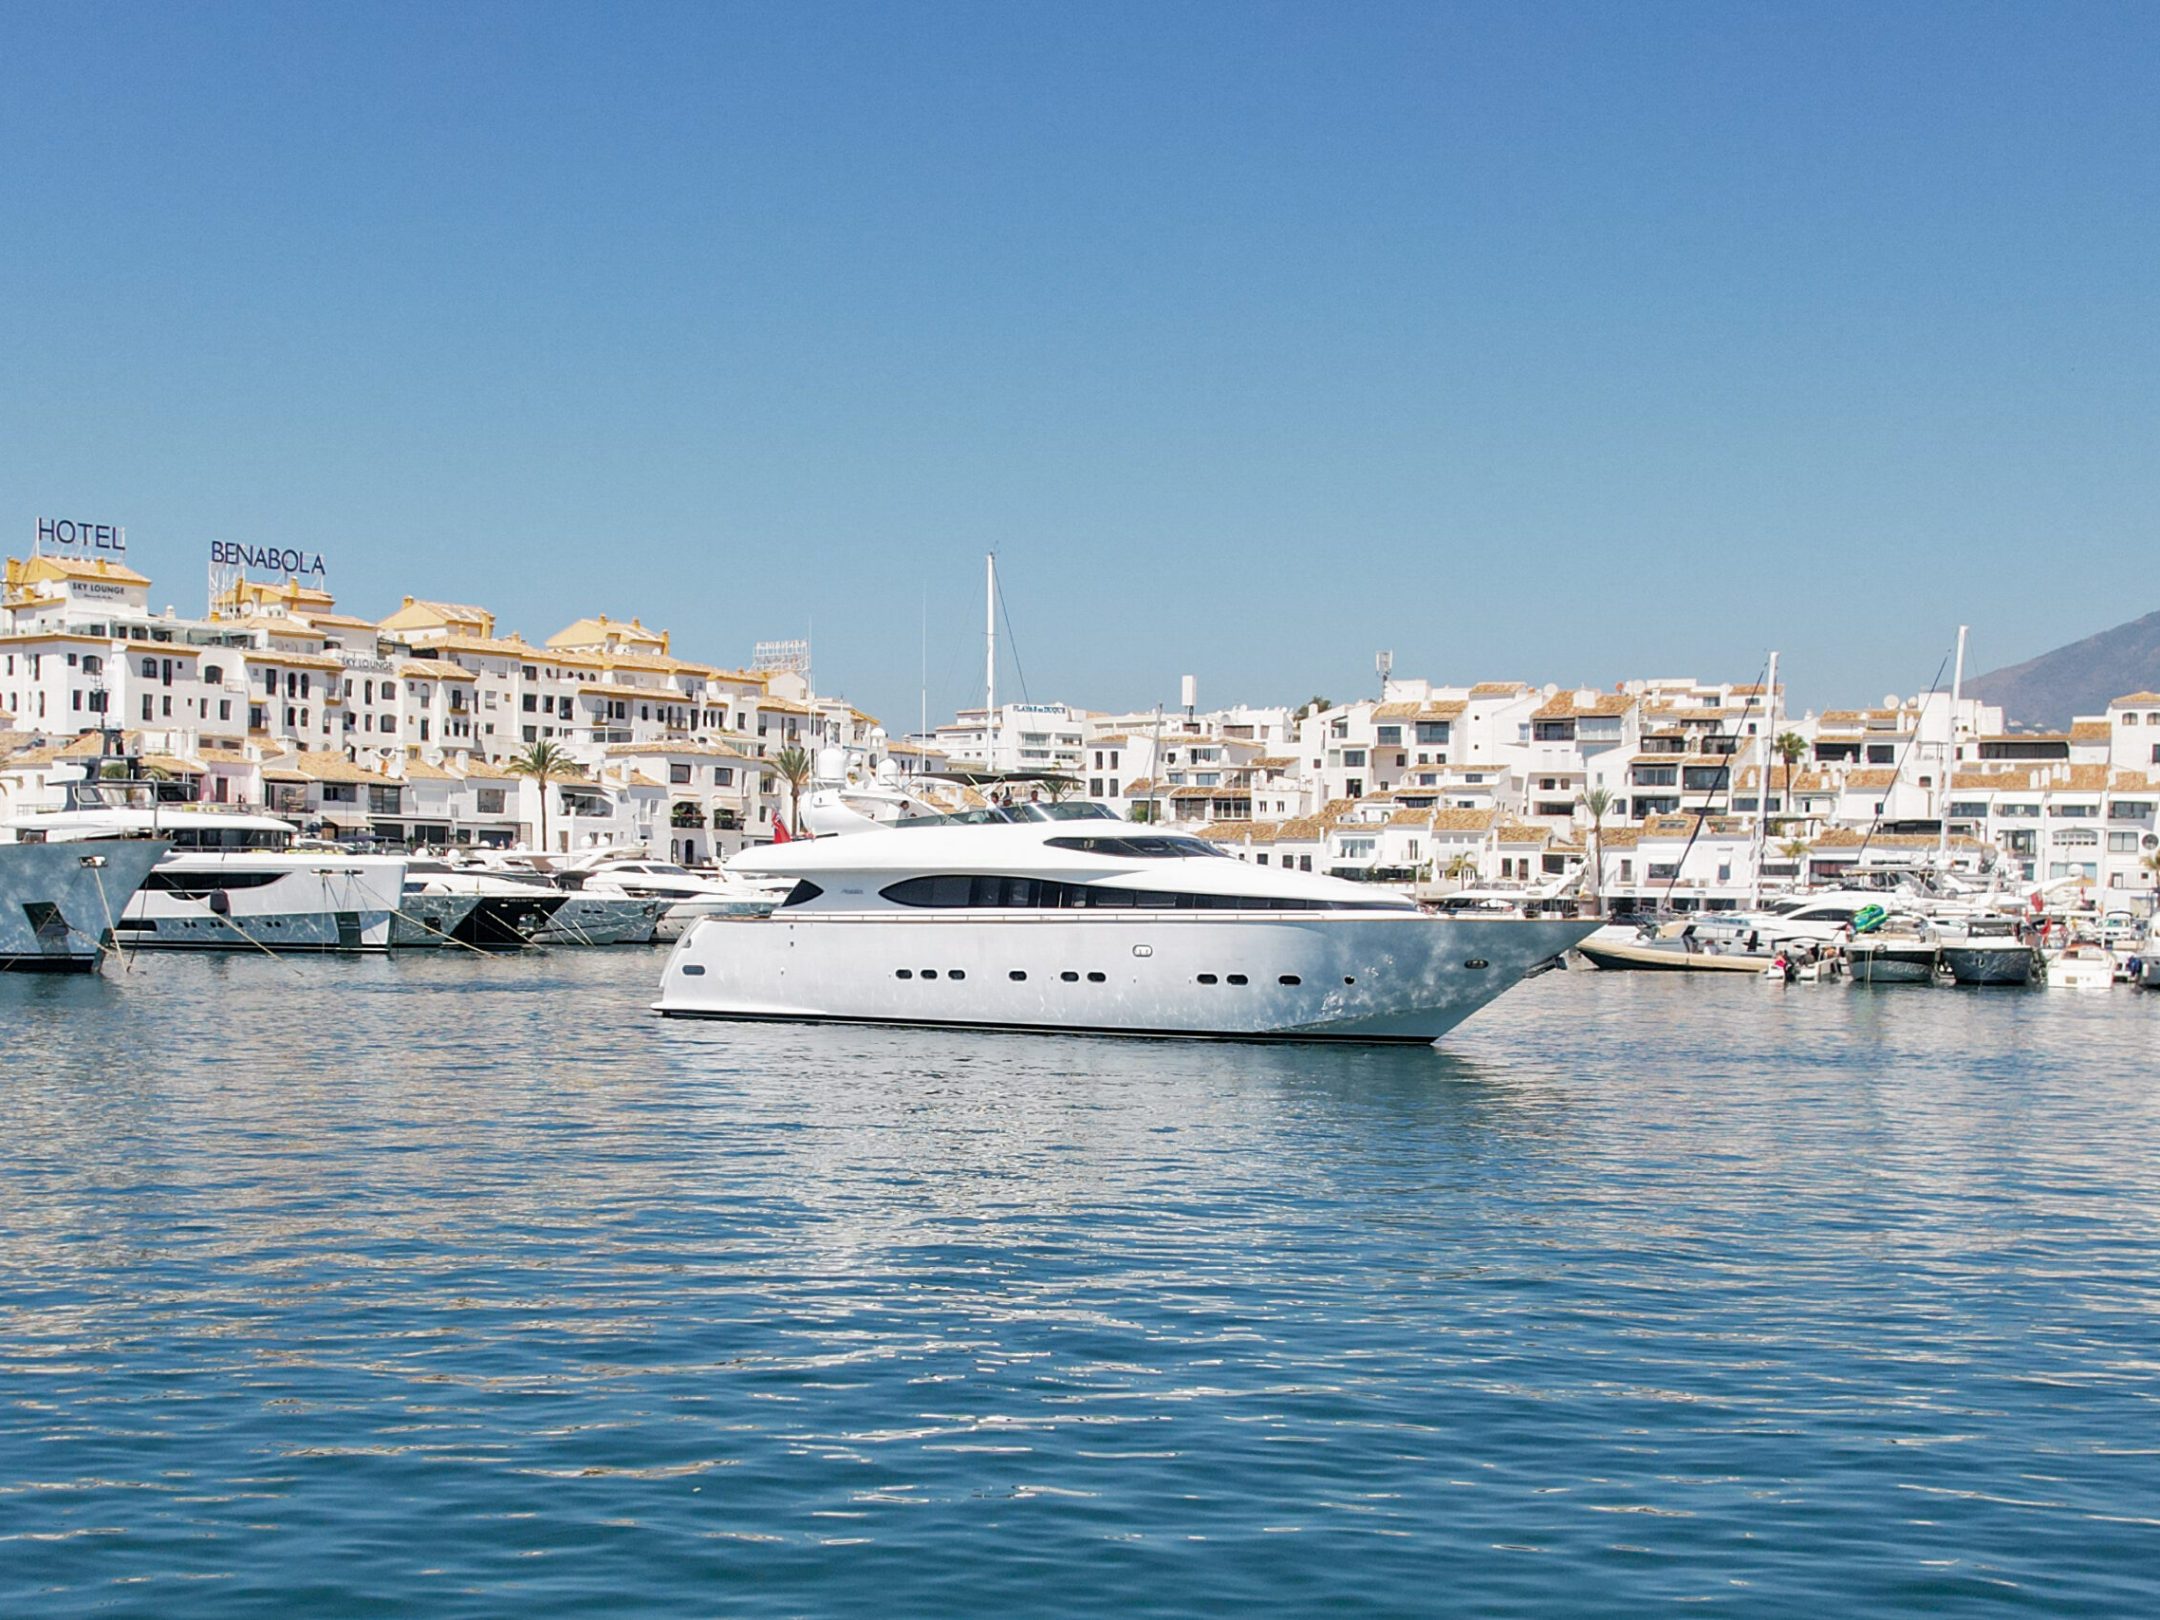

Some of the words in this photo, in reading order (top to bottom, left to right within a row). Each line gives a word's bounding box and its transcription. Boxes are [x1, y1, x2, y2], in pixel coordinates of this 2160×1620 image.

[39, 518, 126, 550] HOTEL
[211, 540, 326, 576] BENABOLA
[72, 582, 88, 591] SKY
[90, 584, 125, 595] LOUNGE
[358, 659, 394, 671] LOUNGE
